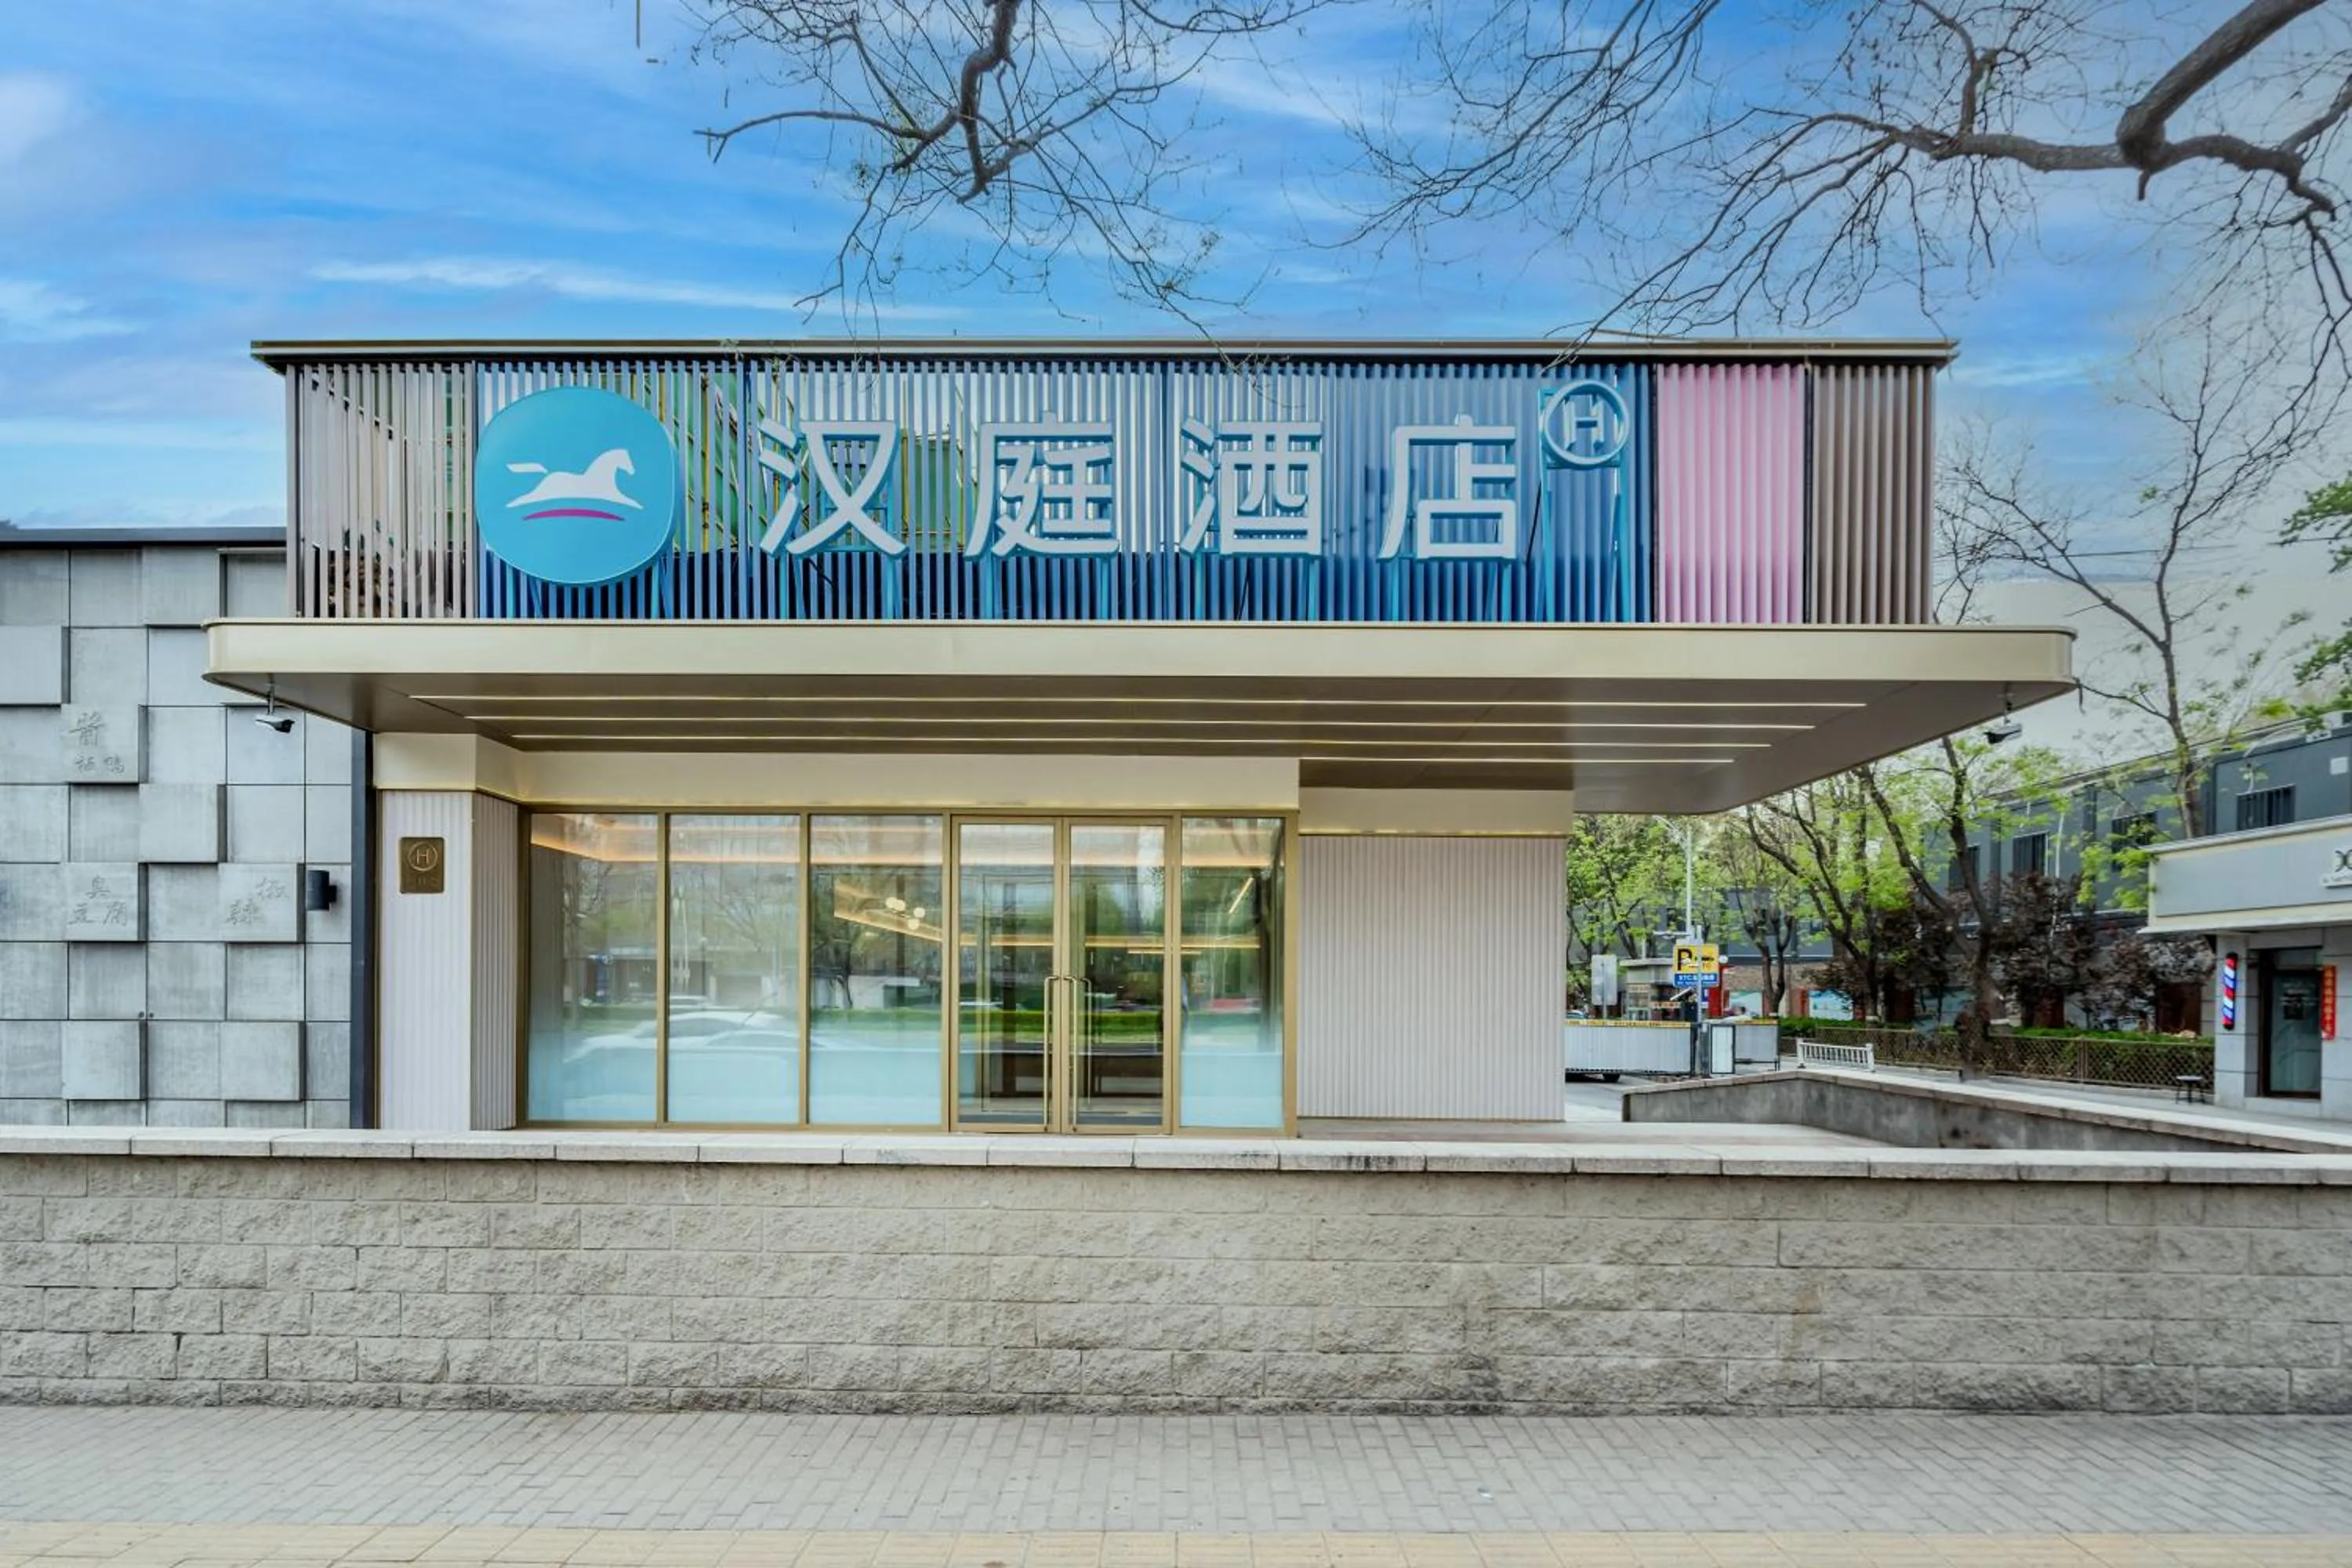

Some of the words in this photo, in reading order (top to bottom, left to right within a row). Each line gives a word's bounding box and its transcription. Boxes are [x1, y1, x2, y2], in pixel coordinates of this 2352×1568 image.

[759, 412, 1516, 561] 汉庭酒店
[416, 848, 429, 865] H
[1677, 948, 1693, 971] P
